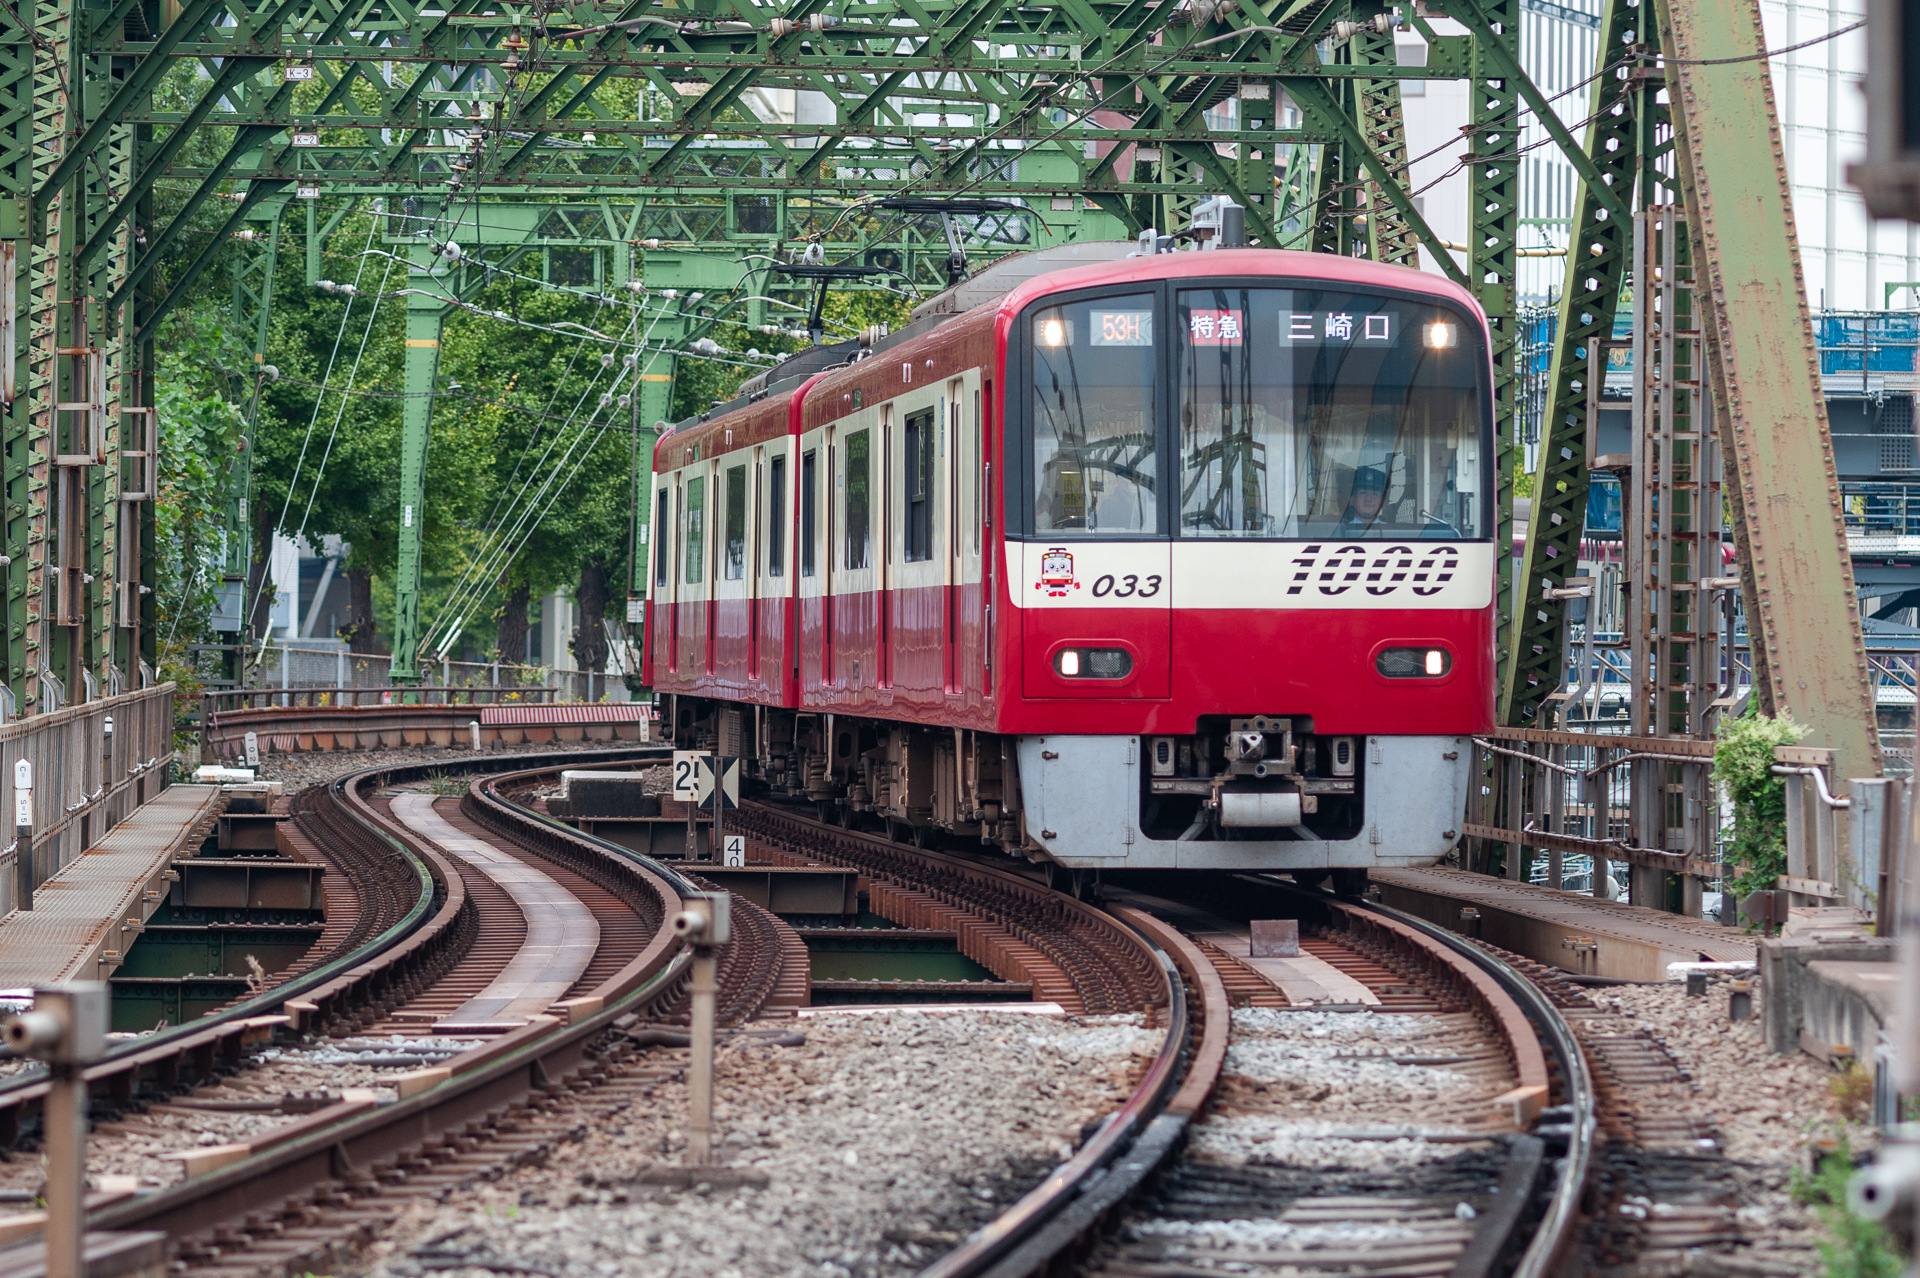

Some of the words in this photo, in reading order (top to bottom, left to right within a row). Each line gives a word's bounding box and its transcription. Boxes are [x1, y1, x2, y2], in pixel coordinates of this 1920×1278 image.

[289, 68, 309, 78] K-3
[296, 135, 315, 145] K-2
[1102, 314, 1140, 341] 53H
[1190, 314, 1241, 339] 特急
[1287, 312, 1390, 341] 三崎口
[1286, 545, 1459, 596] 1000
[1092, 574, 1162, 598] 033
